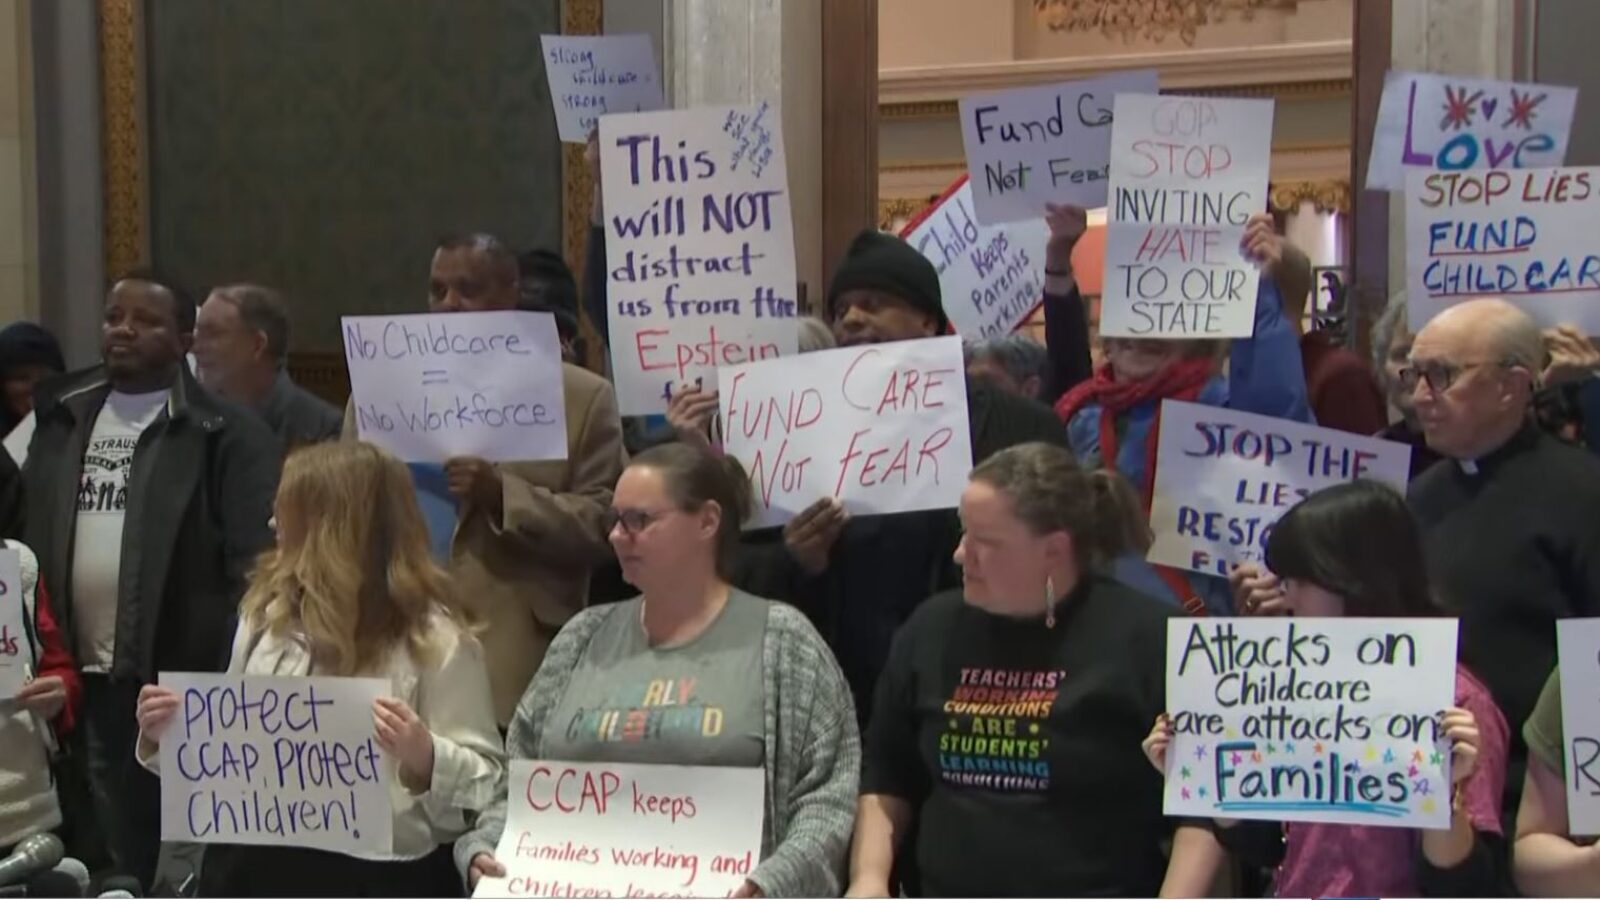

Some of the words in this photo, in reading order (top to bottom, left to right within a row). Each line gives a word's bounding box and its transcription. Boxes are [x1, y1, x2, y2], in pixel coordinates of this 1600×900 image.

[975, 95, 1063, 144] Fund
[1151, 100, 1218, 138] GOP
[616, 134, 717, 184] This
[985, 160, 1032, 197] Not
[1129, 140, 1232, 179] STOP
[1116, 186, 1251, 226] INVITING
[1420, 171, 1511, 207] STOP
[613, 195, 686, 238] will
[703, 190, 784, 235] NOT
[1135, 224, 1226, 266] HATE
[1429, 216, 1536, 256] FUND
[611, 242, 765, 282] distract
[618, 298, 652, 317] us
[662, 282, 740, 318] from
[750, 286, 796, 319] the
[1117, 264, 1168, 299] TO
[1181, 268, 1247, 301] OUR
[1128, 301, 1226, 335] STATE
[345, 323, 377, 361] No
[383, 320, 532, 360] Childcare
[636, 325, 780, 379] Epstein
[359, 404, 395, 432] No
[396, 392, 557, 433] Workforce
[726, 372, 823, 442] FUND
[842, 348, 956, 416] CARE
[1183, 421, 1293, 467] STOP
[1178, 623, 1331, 676] Attacks
[1356, 633, 1416, 667] on
[960, 668, 1067, 689] TEACHERS'
[1214, 668, 1371, 708] Childcare
[972, 717, 1017, 736] ARE
[1173, 710, 1224, 735] are
[1242, 704, 1371, 742] attacks
[940, 734, 1049, 759] STUDENTS'
[1214, 742, 1409, 805] Families
[527, 767, 620, 816] CCAP
[632, 780, 697, 823] keeps
[710, 850, 752, 876] and
